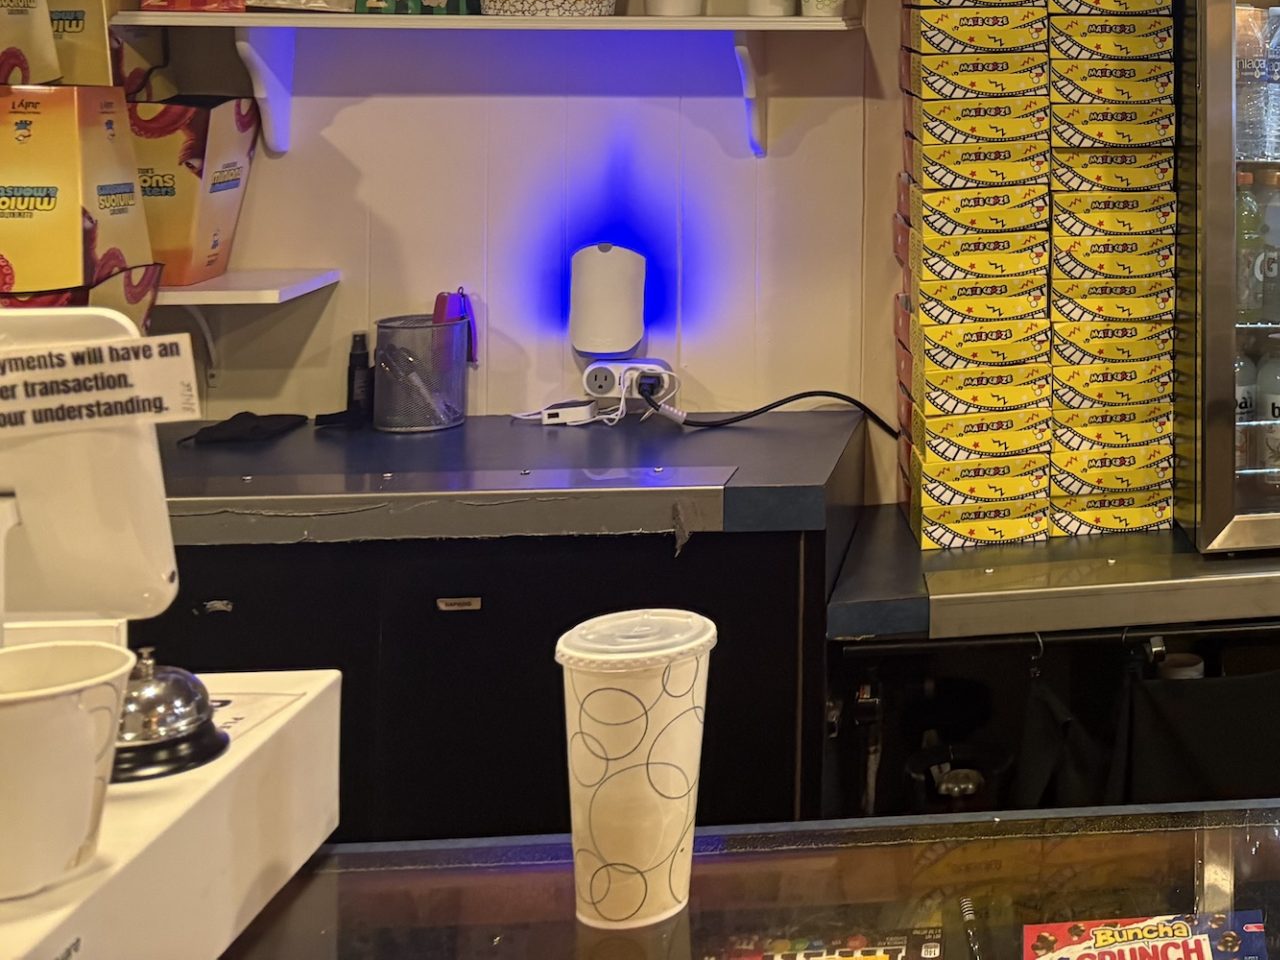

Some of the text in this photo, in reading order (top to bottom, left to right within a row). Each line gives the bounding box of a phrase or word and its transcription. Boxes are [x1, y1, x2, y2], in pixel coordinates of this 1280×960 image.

[71, 346, 104, 366] will
[109, 345, 153, 363] have
[158, 341, 181, 358] an
[24, 371, 134, 399] transaction.
[32, 395, 169, 425] understanding.
[1092, 921, 1190, 949] Buncha
